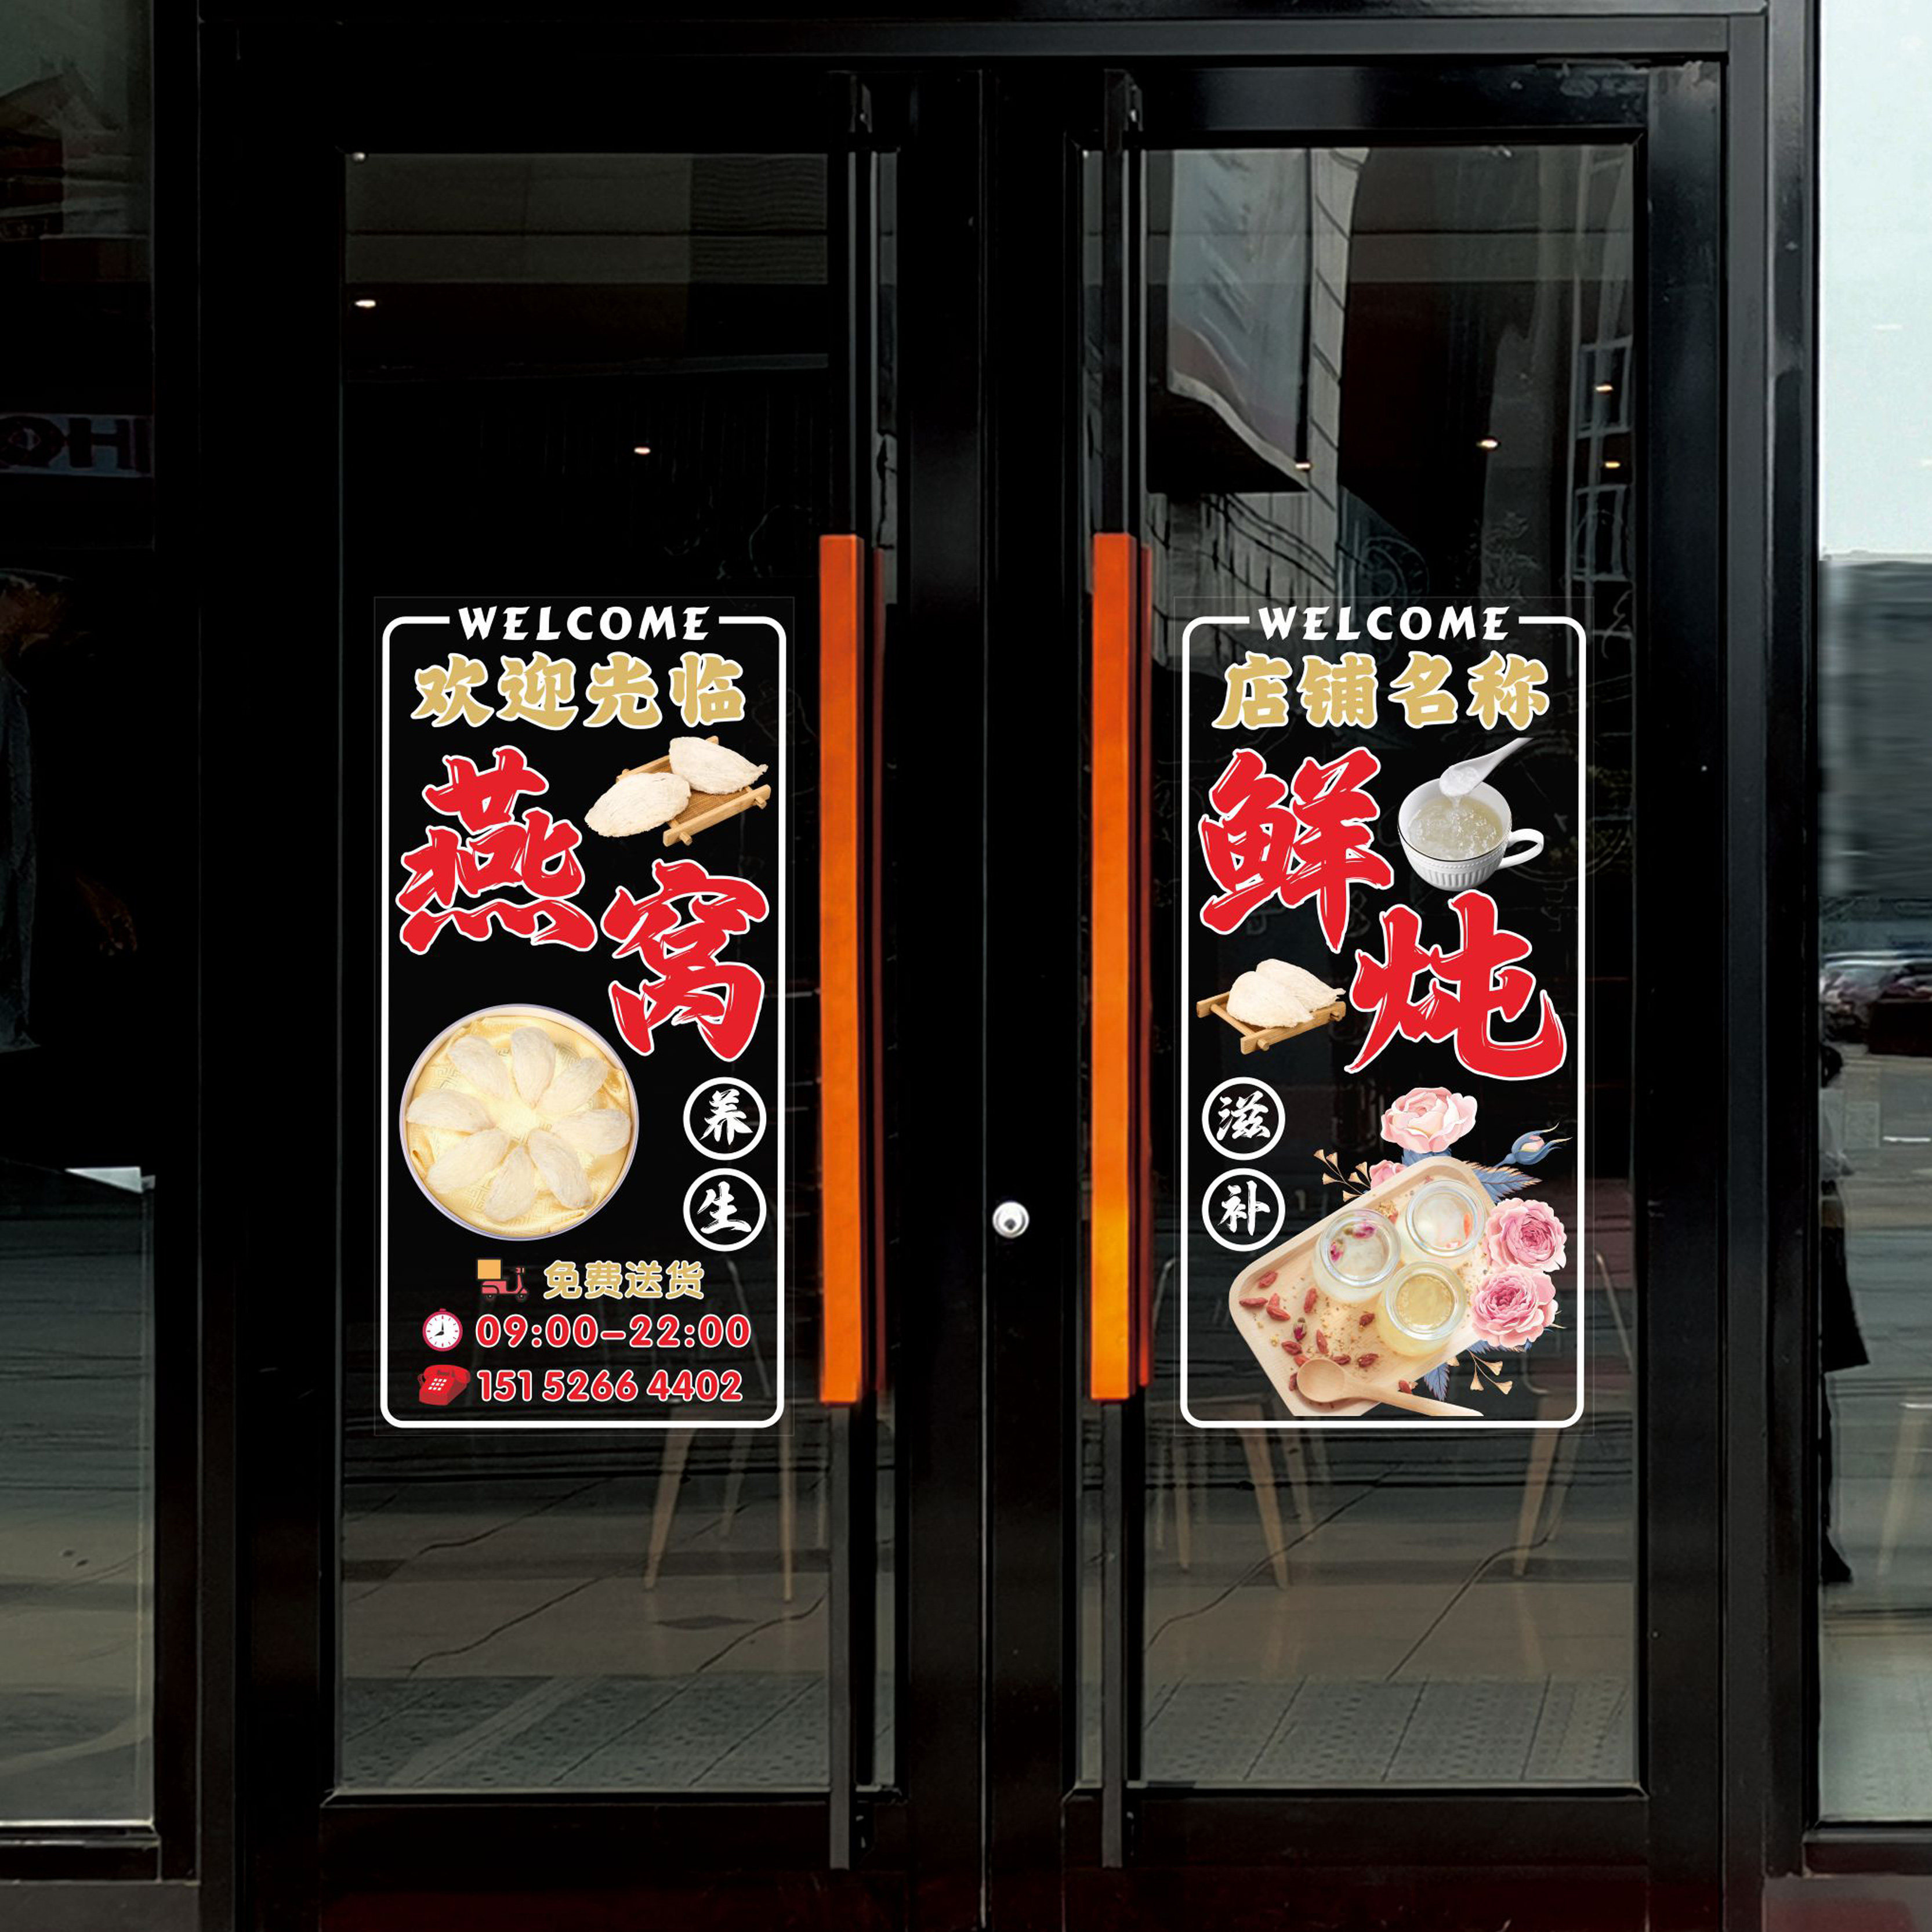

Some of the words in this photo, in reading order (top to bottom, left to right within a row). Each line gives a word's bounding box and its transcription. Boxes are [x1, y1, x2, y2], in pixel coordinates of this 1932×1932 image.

[458, 606, 710, 641] WELCOME
[1257, 606, 1510, 641] WELCOME
[410, 651, 746, 731] 欢迎光临
[1211, 650, 1550, 731] 店铺名称
[395, 745, 771, 1063] 燕窝
[1197, 746, 1568, 1081] 鲜炖
[695, 1087, 755, 1237] 养生
[1215, 1091, 1273, 1238] 滋补
[543, 1259, 705, 1300] 免费送货
[476, 1369, 533, 1402] 151
[542, 1369, 639, 1402] 5266
[646, 1369, 744, 1402] 4402
